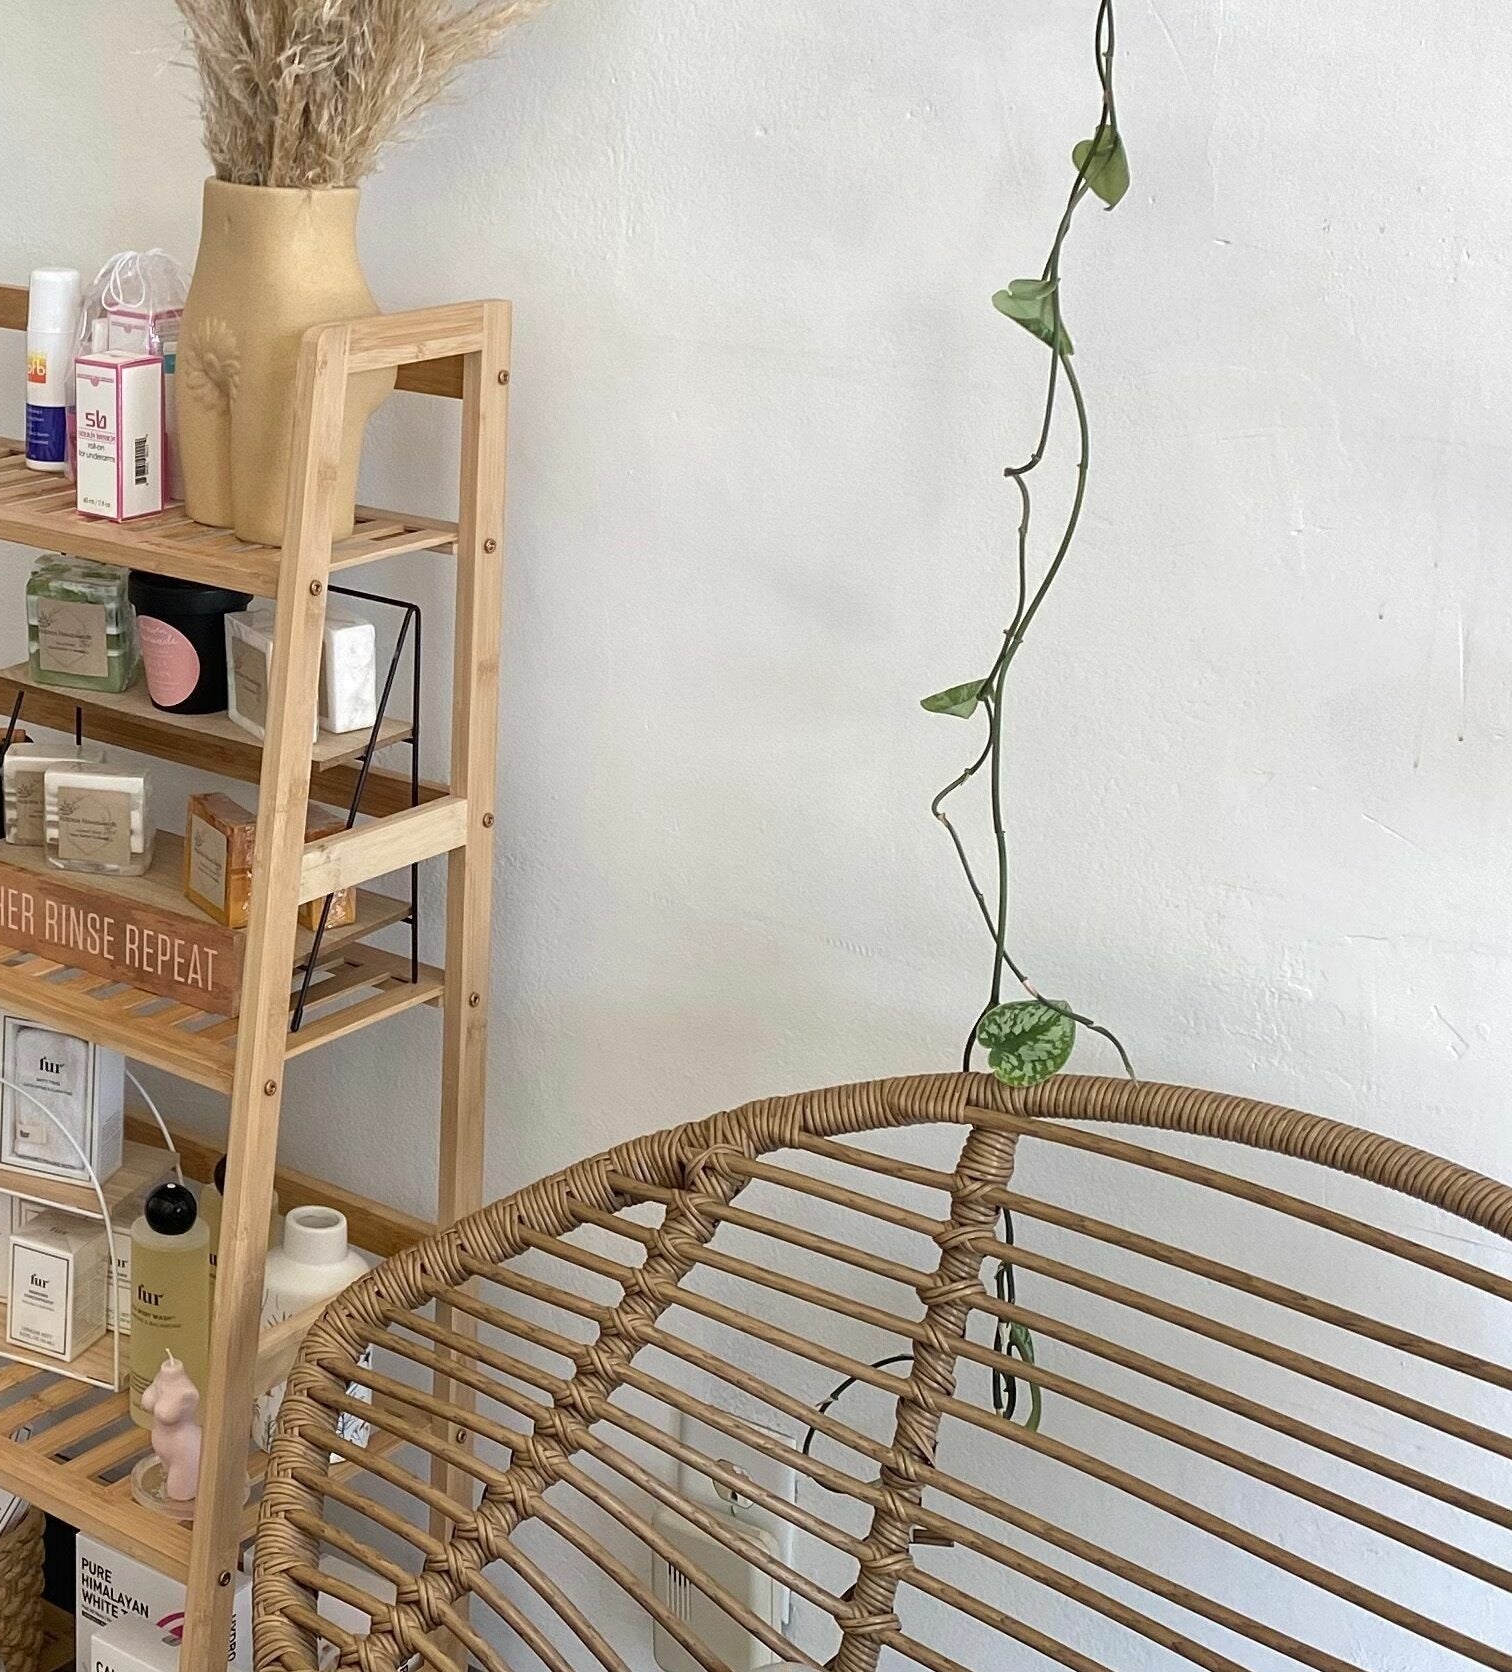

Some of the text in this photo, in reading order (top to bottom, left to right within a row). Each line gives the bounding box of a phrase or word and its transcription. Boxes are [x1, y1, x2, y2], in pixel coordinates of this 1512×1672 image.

[85, 409, 107, 430] sb
[45, 899, 115, 961] RINSE
[125, 923, 218, 991] REPEAT
[39, 1056, 65, 1074] fur
[30, 1273, 50, 1289] fur
[138, 1283, 165, 1307] fur
[81, 1556, 113, 1584] PURE
[81, 1572, 149, 1619] HIMALAYAN
[81, 1587, 119, 1619] WHITE
